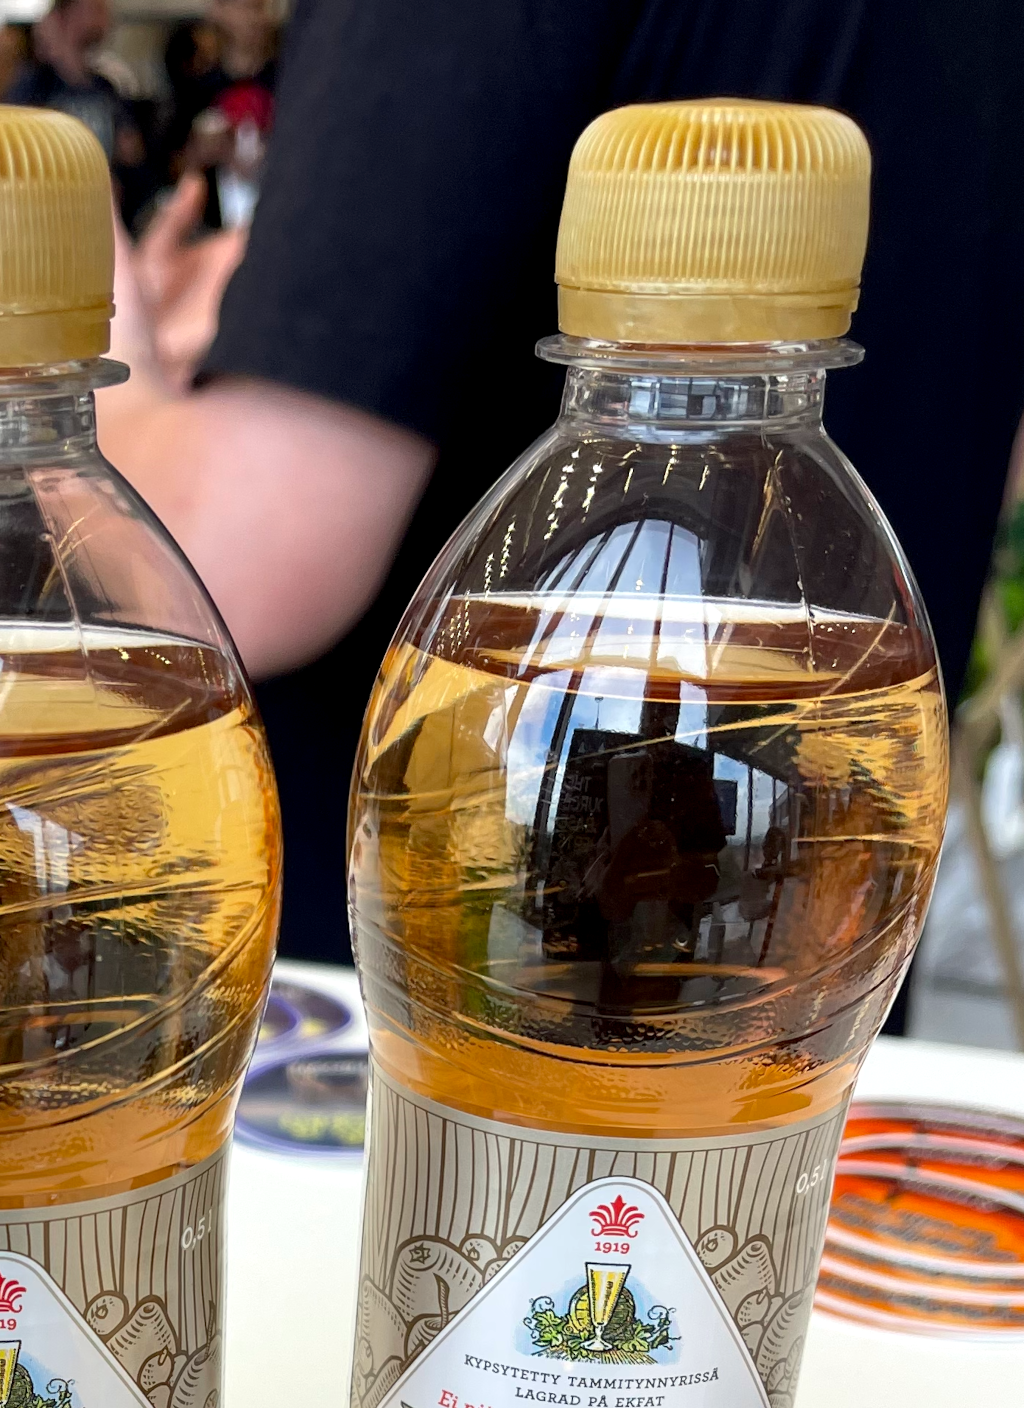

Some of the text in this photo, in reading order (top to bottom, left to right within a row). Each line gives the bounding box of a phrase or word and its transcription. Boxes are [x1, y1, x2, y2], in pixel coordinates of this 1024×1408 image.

[594, 1241, 630, 1255] 1919
[464, 1354, 720, 1390] KYPSYTETTY TAMMITYNNYRISSÄ
[515, 1387, 665, 1408] LAGRAD PÅ EKFAT
